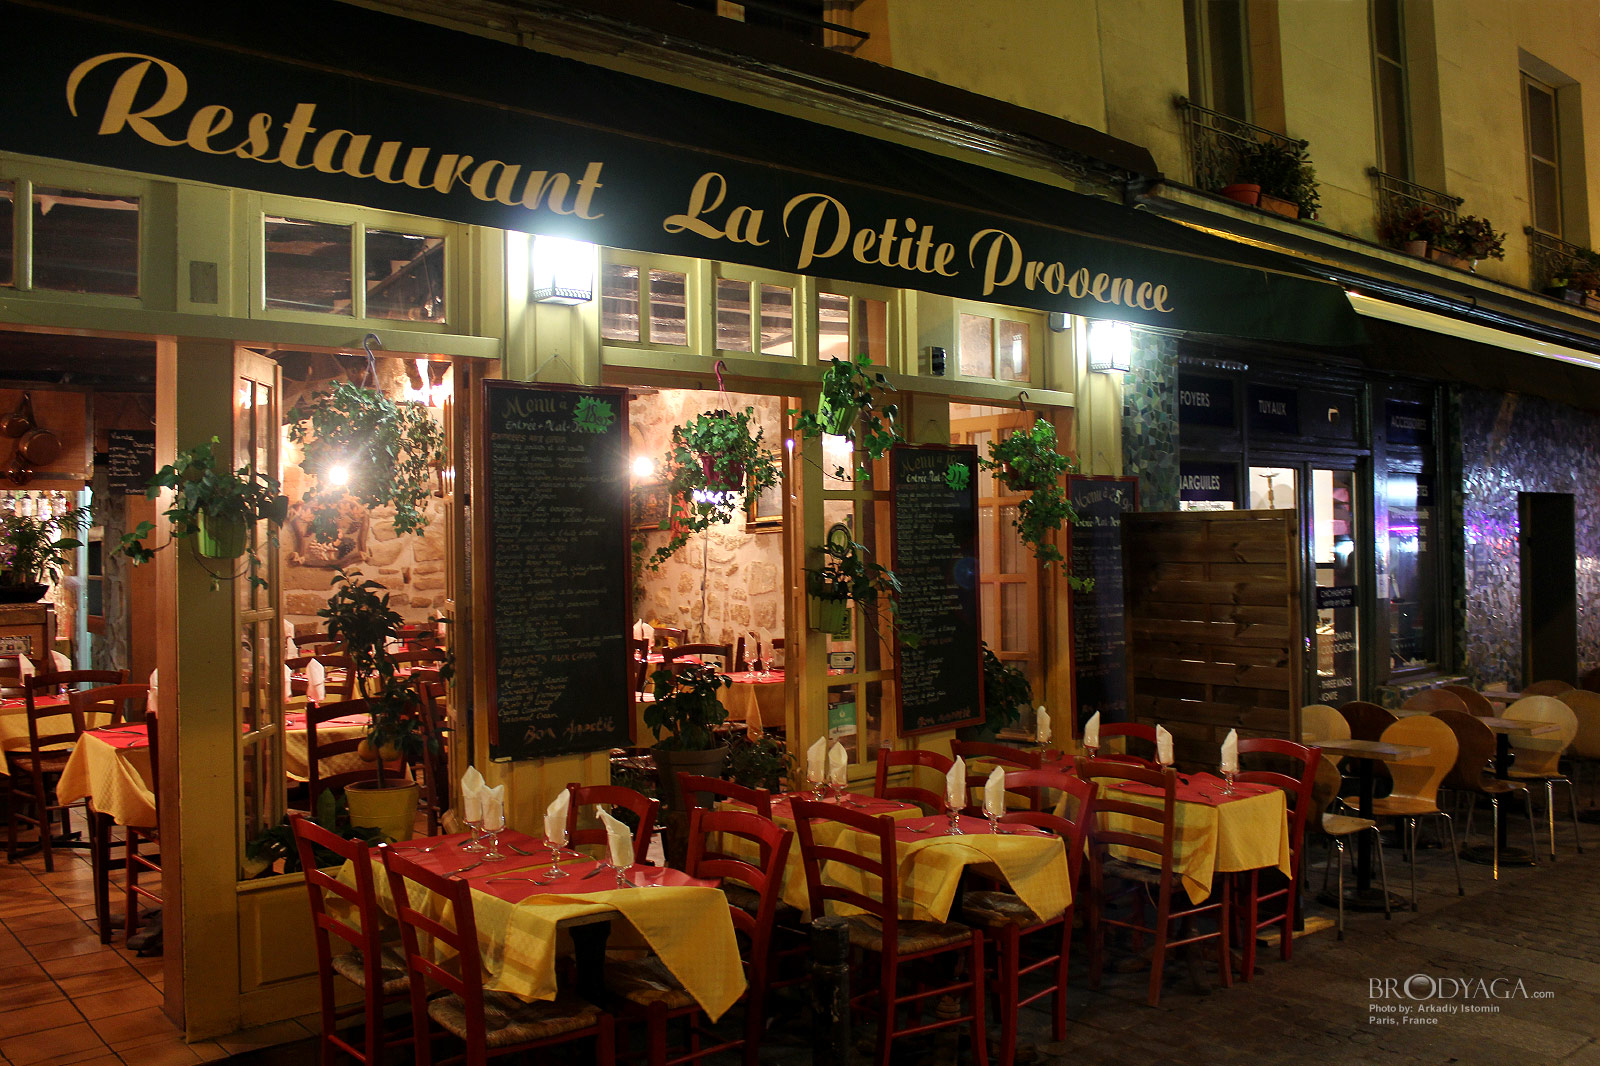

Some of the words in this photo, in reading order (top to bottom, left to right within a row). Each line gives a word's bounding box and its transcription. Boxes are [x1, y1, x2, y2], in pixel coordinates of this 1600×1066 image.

[66, 51, 605, 221] Restaurant
[662, 172, 770, 247] La
[783, 192, 959, 277] Petite
[968, 228, 1175, 314] Provence
[500, 394, 557, 419] Menu
[1179, 390, 1211, 408] FOYERS
[1257, 399, 1288, 416] TUYAUX
